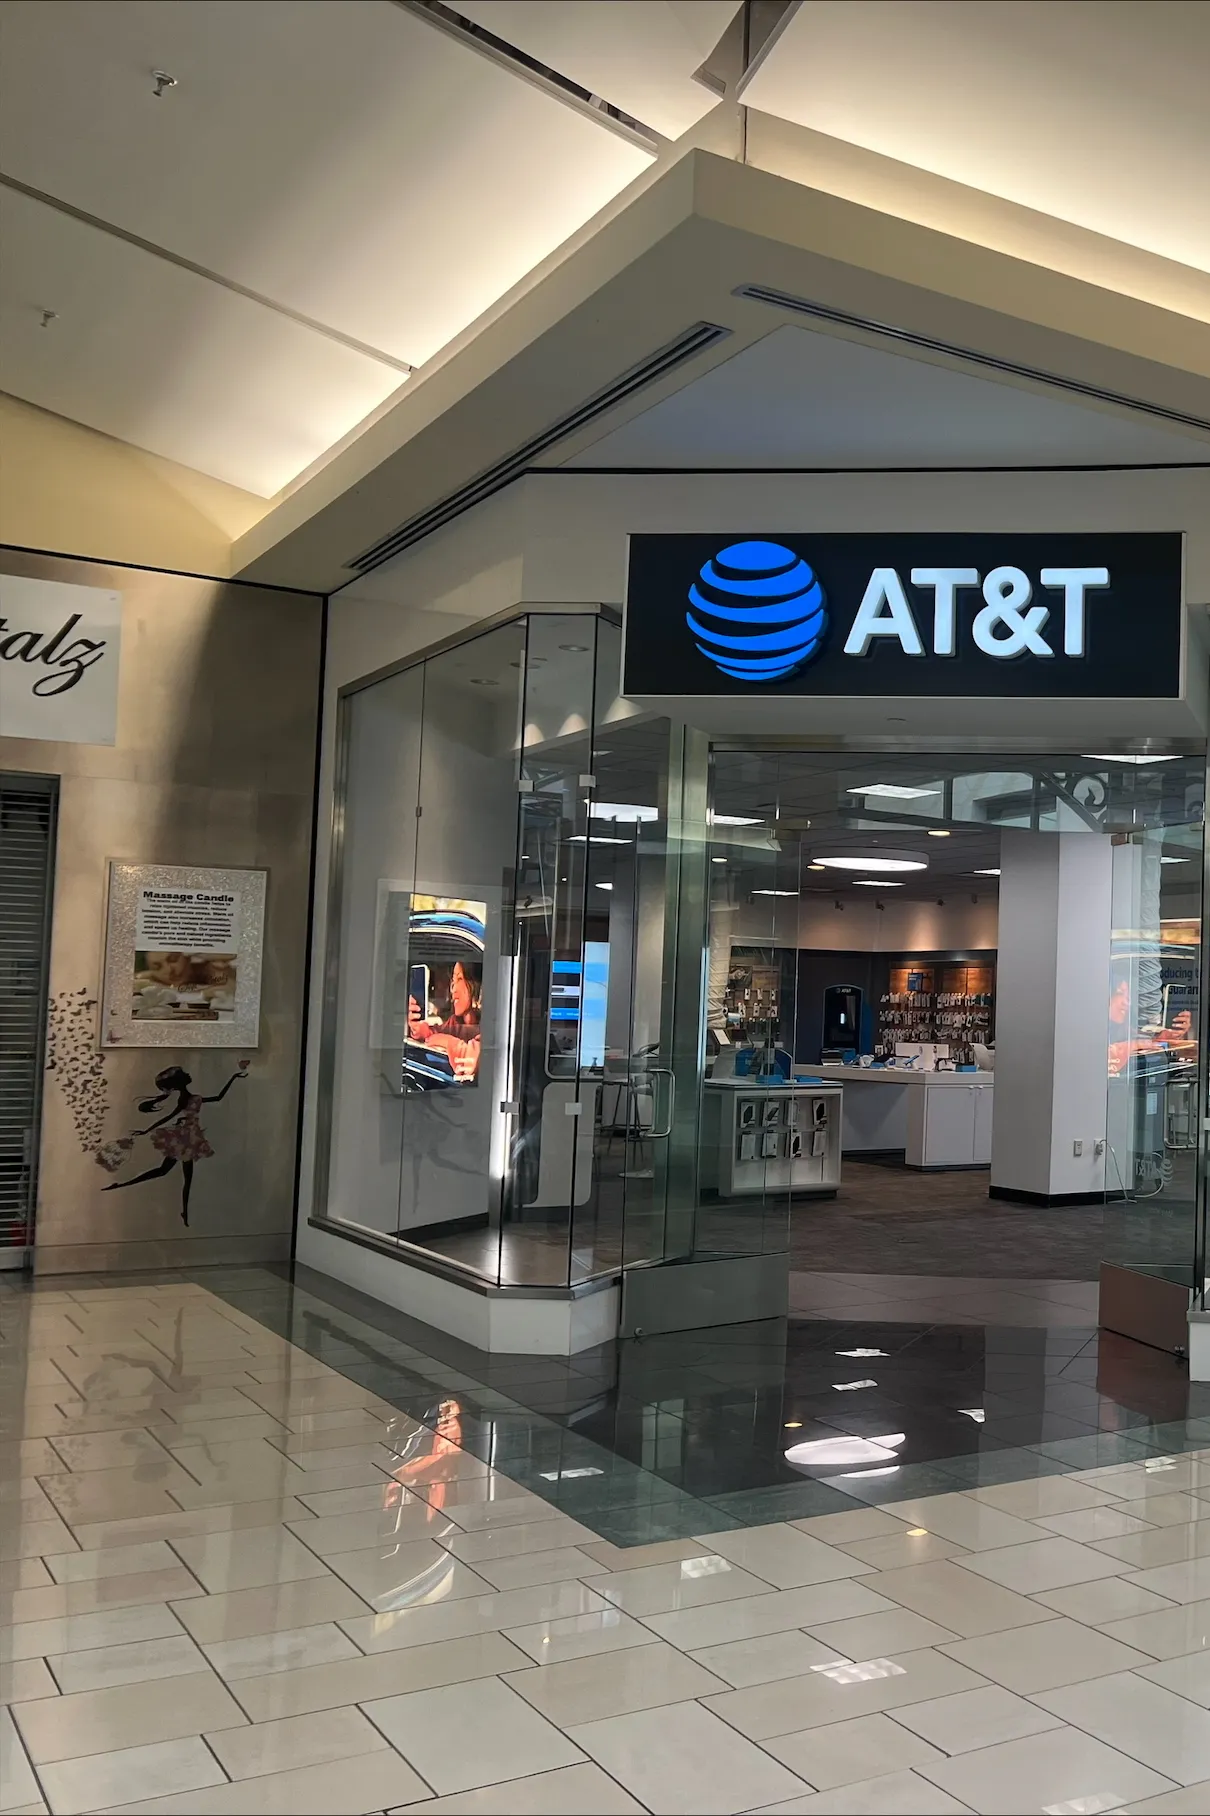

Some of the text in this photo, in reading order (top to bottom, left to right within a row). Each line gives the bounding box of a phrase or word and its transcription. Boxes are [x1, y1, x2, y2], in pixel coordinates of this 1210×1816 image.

[843, 565, 1111, 660] AT&T
[143, 891, 193, 901] Massage
[196, 893, 234, 902] Candle
